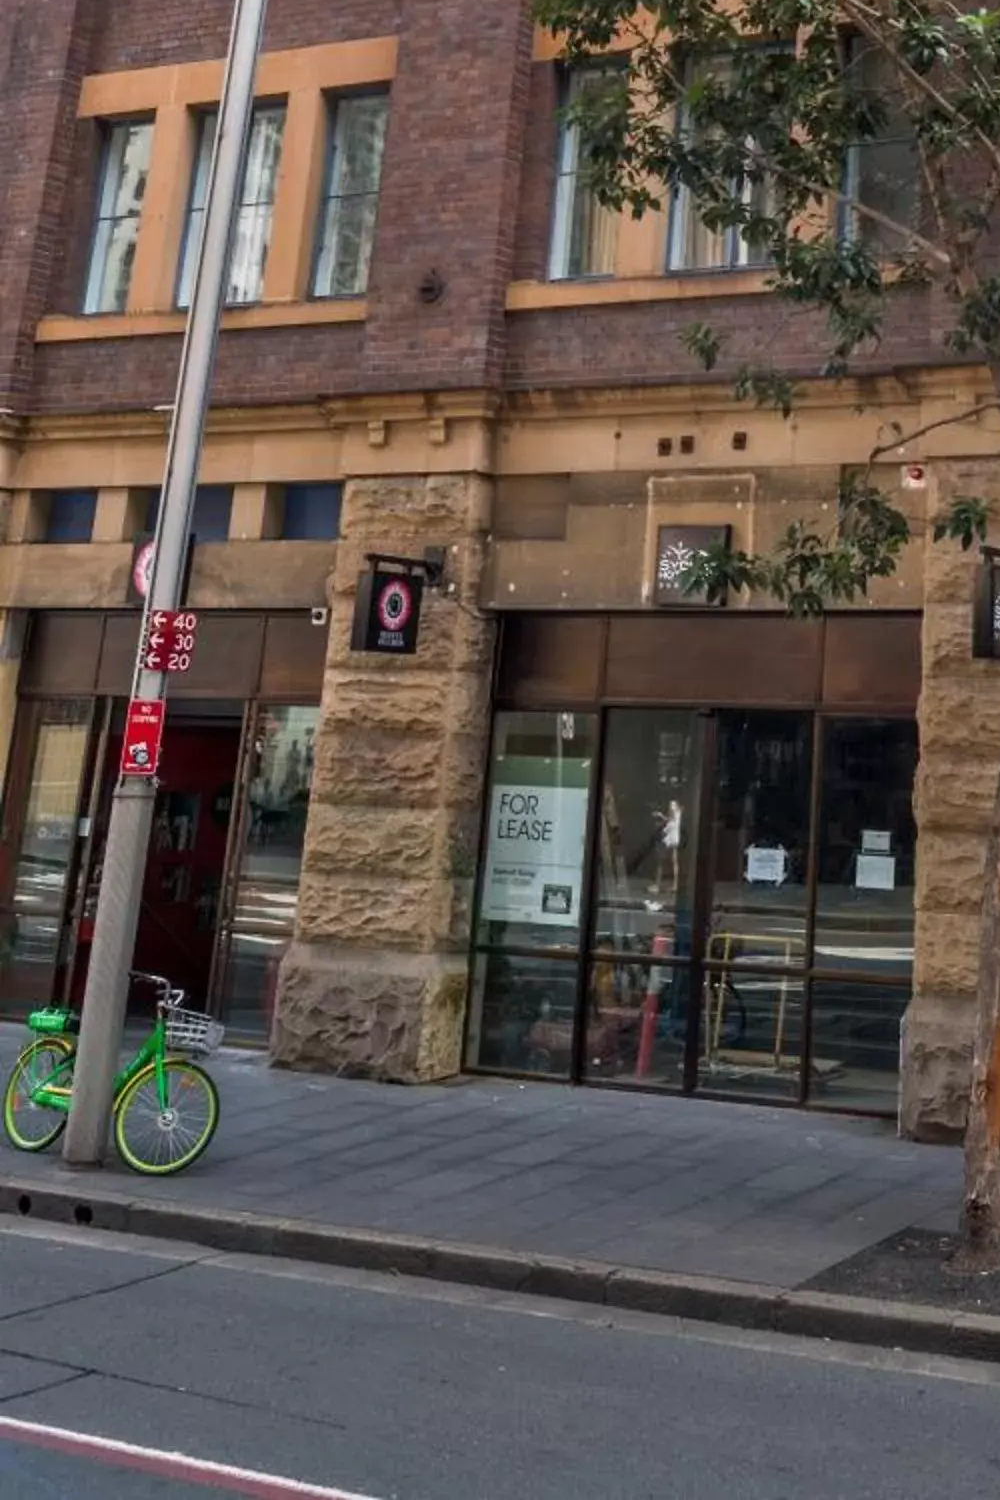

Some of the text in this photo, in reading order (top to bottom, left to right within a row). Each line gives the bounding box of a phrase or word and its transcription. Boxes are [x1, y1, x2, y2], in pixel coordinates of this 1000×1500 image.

[172, 613, 197, 631] 40
[174, 634, 195, 651] 30
[167, 653, 191, 670] 20
[500, 793, 539, 815] FOR
[497, 819, 553, 841] LEASE
